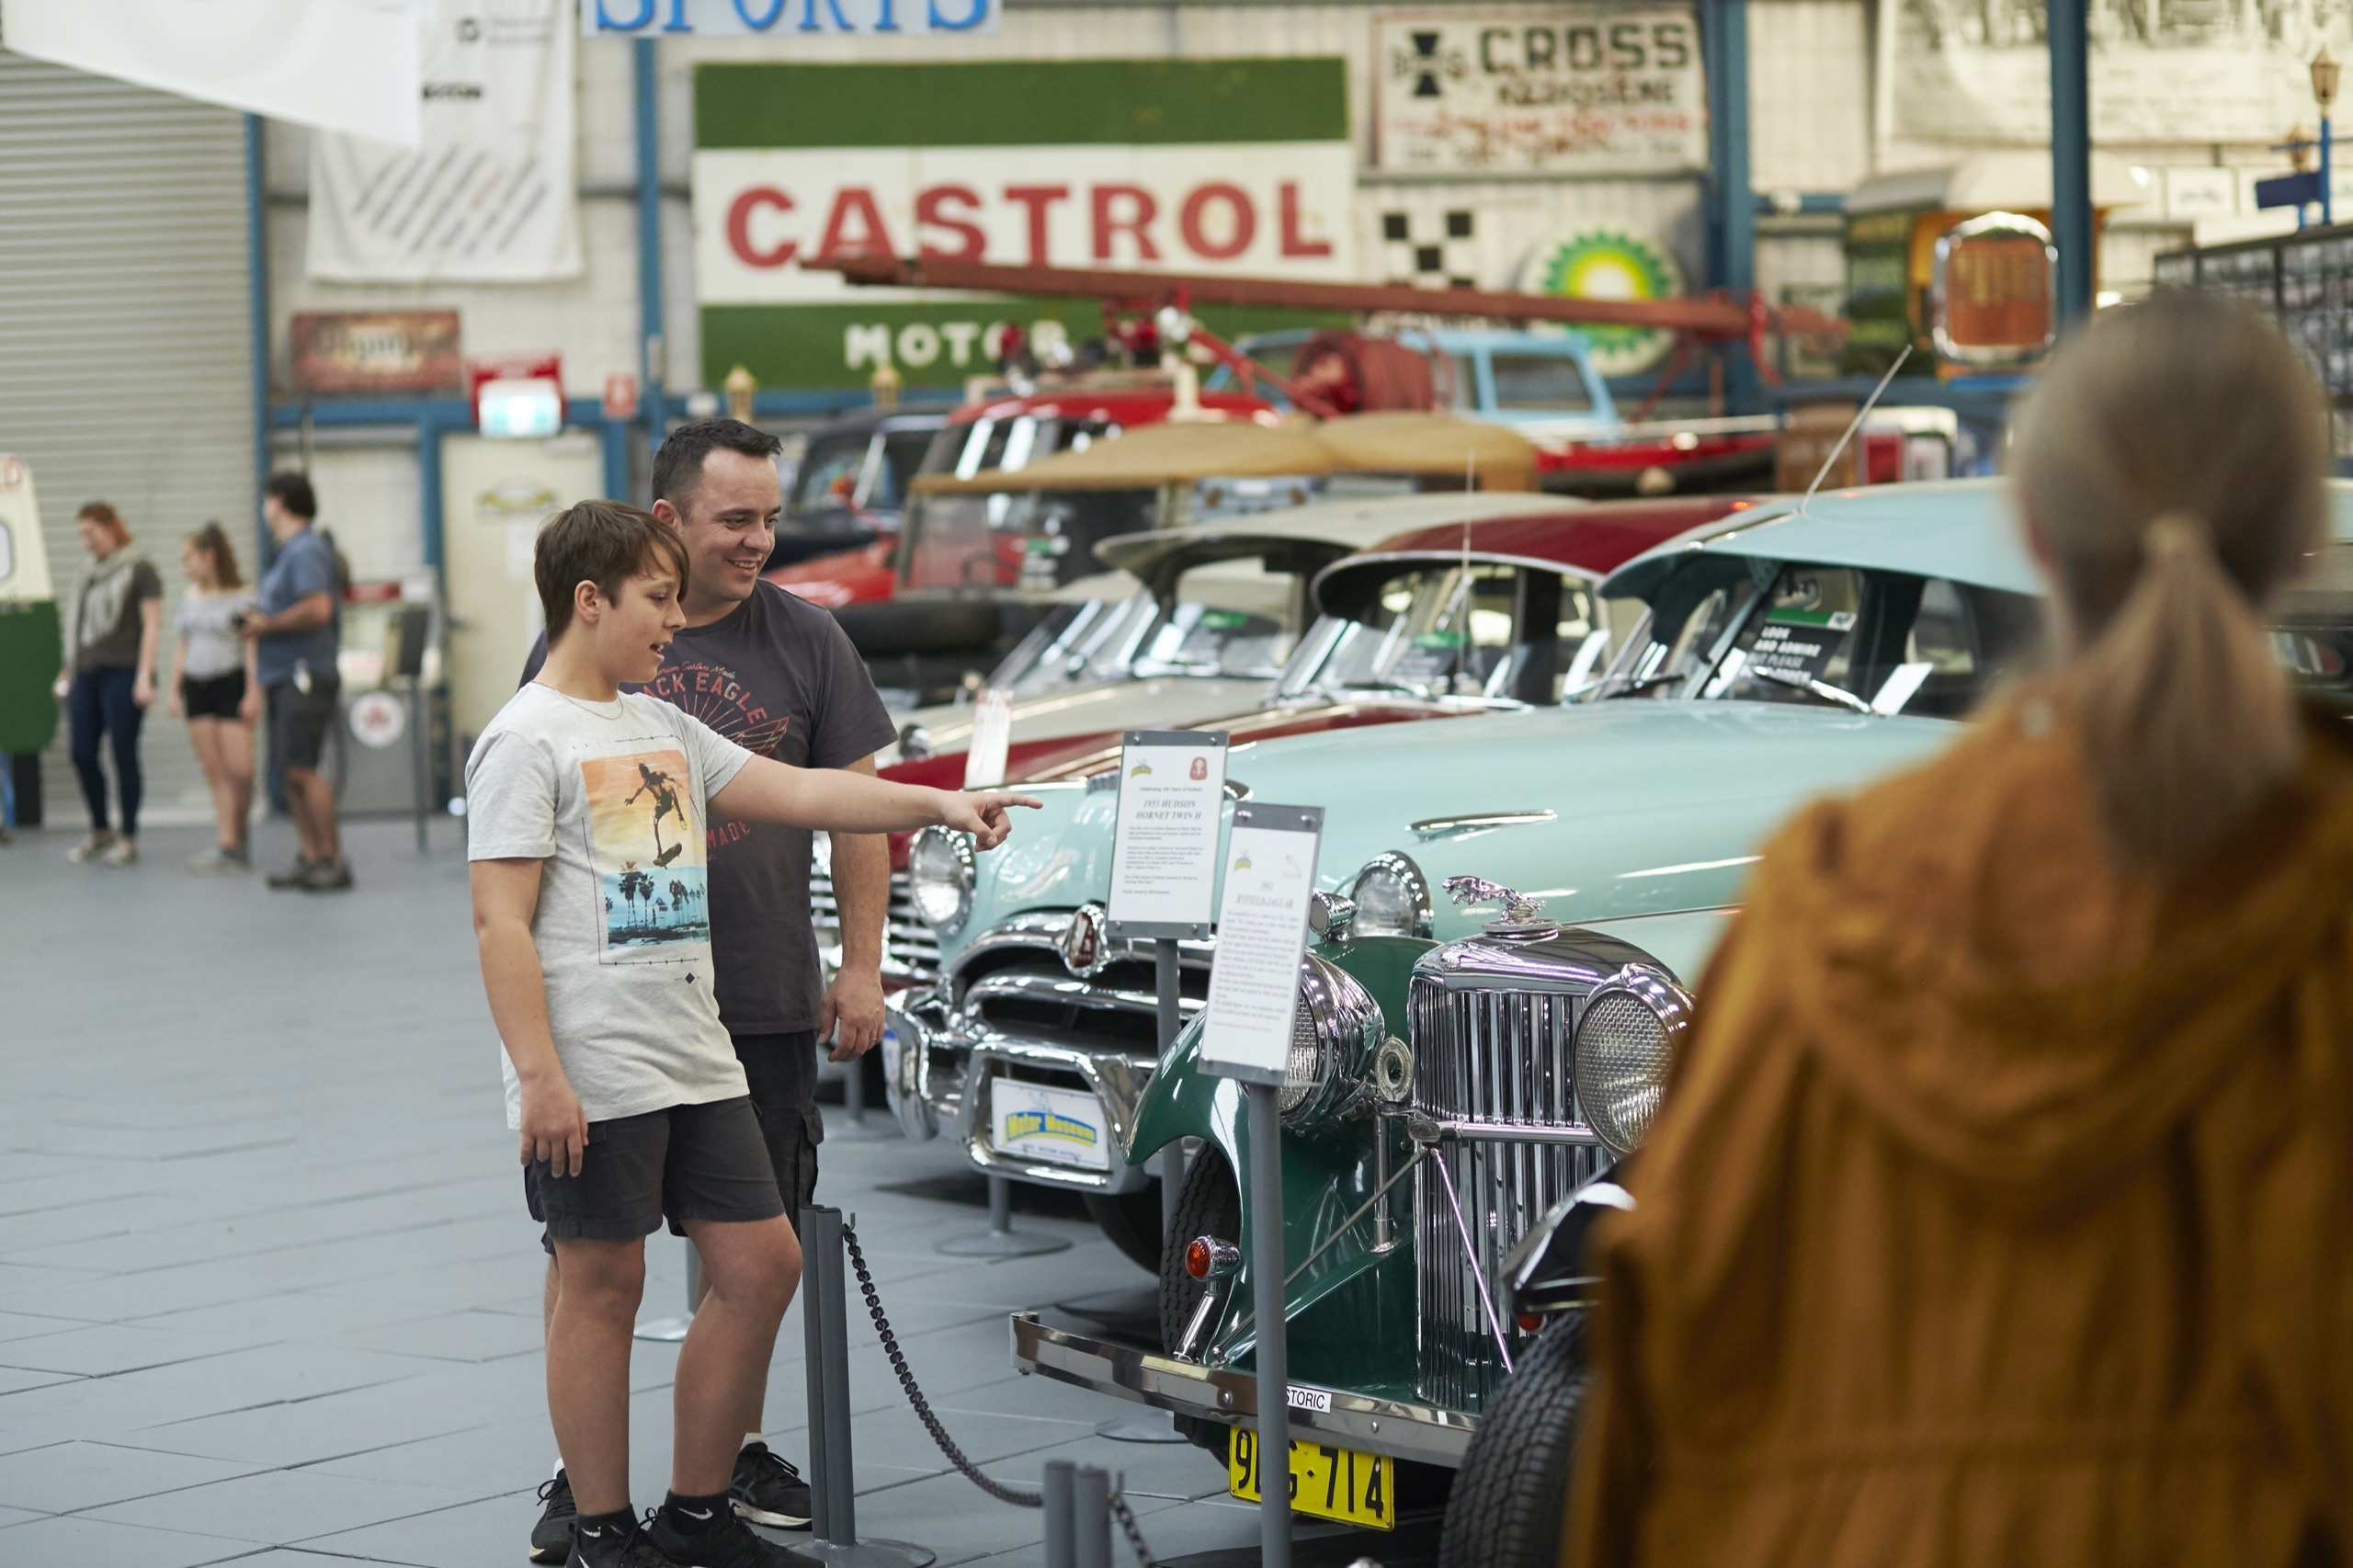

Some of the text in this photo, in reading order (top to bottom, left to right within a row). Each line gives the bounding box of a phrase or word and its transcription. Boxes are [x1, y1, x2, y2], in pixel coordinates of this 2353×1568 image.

[1480, 23, 1690, 74] CROSS
[724, 182, 1332, 268] CASTROL
[696, 672, 767, 724] EAGLE
[1135, 811, 1170, 820] HORNET
[1172, 812, 1193, 820] TWIN
[1161, 800, 1197, 809] HUDSON
[1008, 1113, 1096, 1142] Motor Museum
